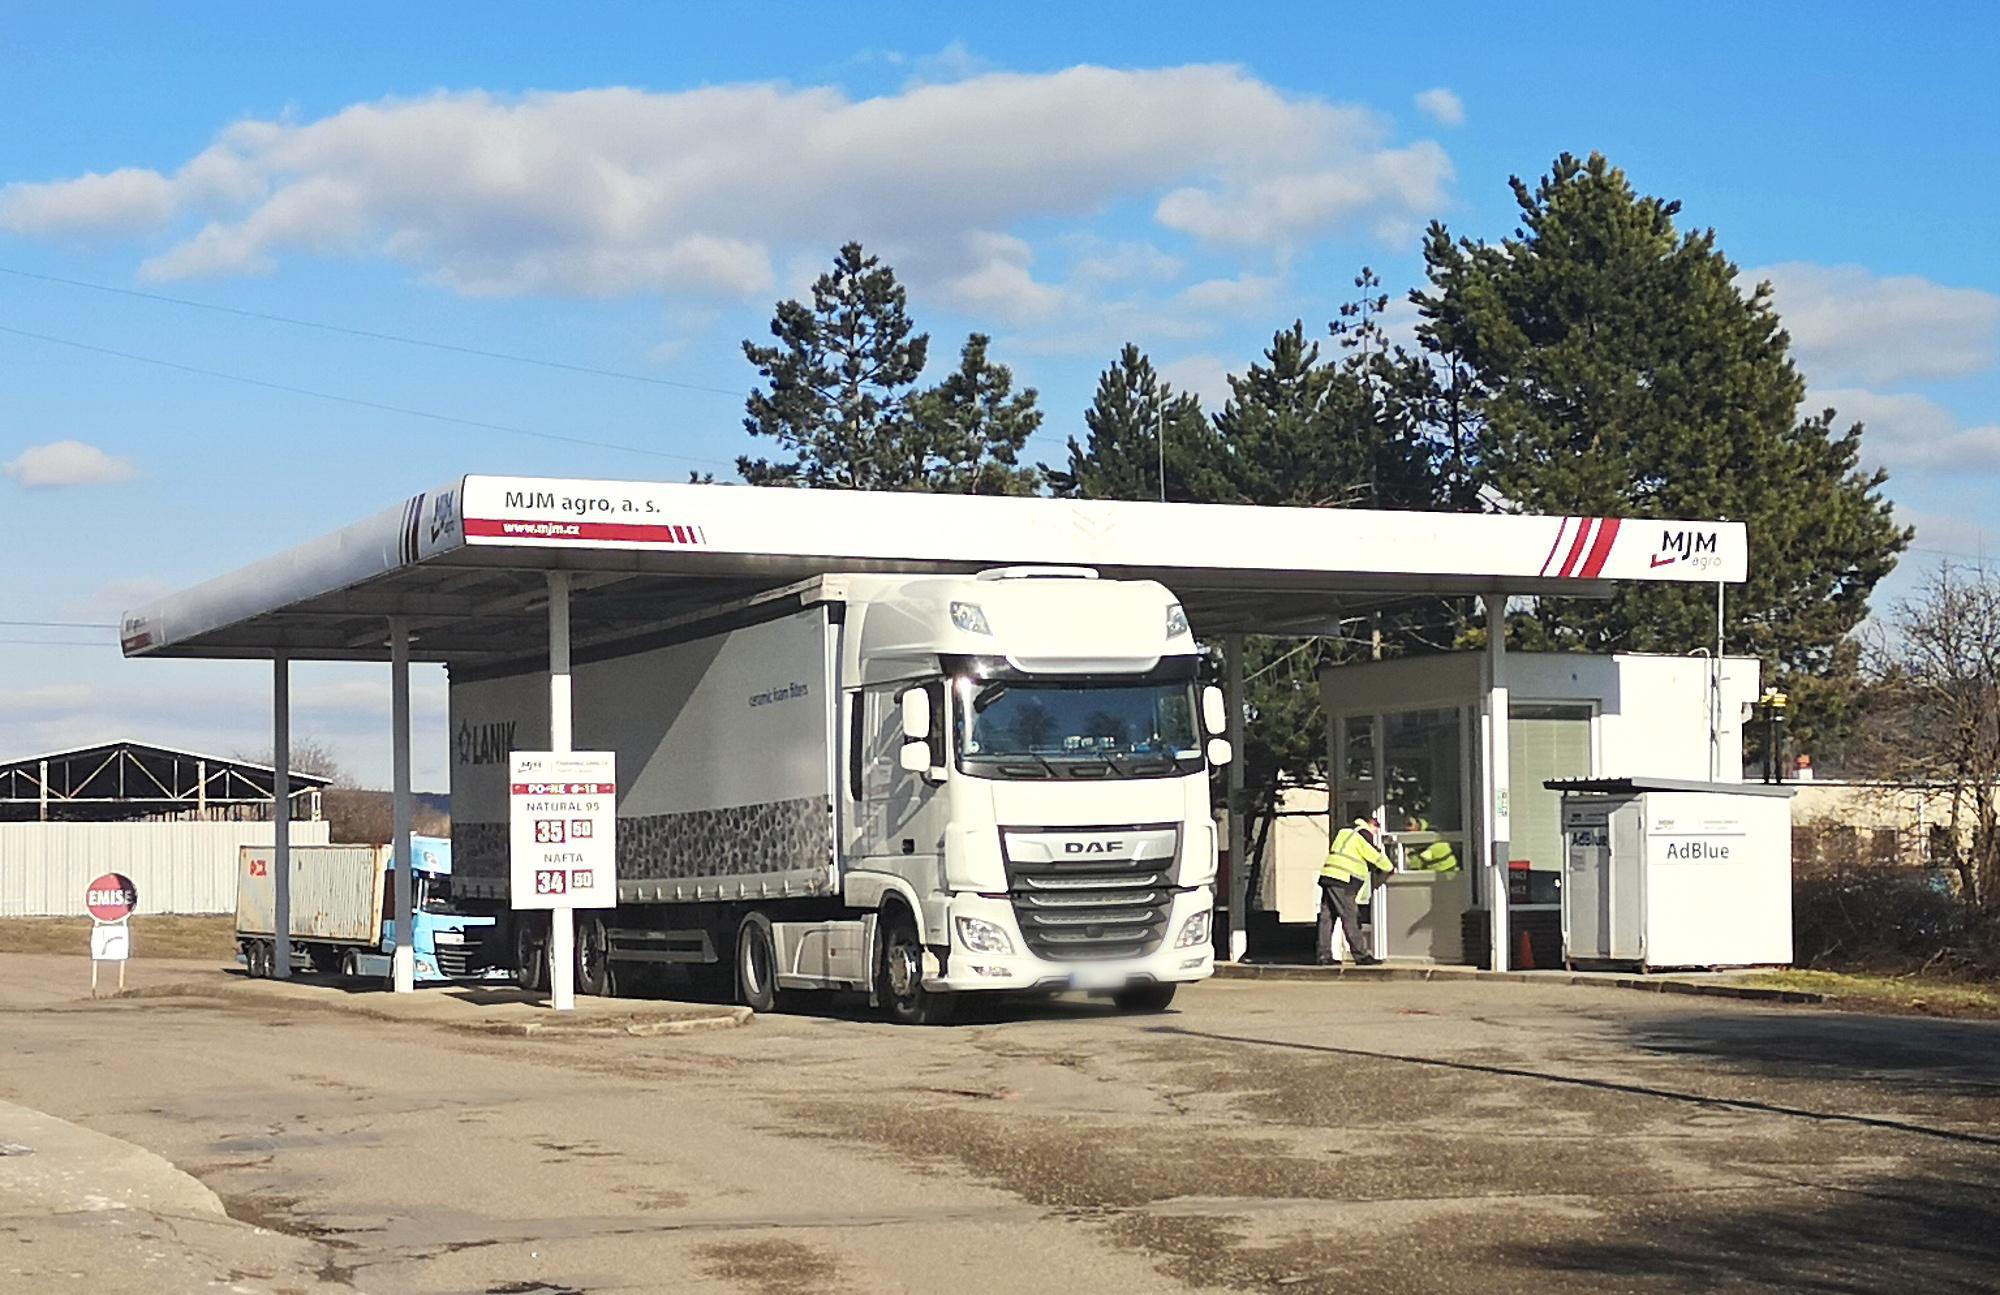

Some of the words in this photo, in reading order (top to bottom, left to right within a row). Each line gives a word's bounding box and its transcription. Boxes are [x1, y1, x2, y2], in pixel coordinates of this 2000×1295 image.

[505, 491, 555, 509] MJM
[561, 497, 615, 515] agro,
[622, 500, 639, 512] a.
[645, 501, 660, 513] s.
[503, 523, 581, 535] www.mjm.cz
[1662, 529, 1717, 560] MJM
[1692, 557, 1722, 571] agro
[526, 802, 582, 812] NATURAL
[536, 821, 563, 843] 35
[1065, 841, 1123, 853] DAF
[1667, 842, 1730, 859] AdBlue
[544, 852, 583, 863] NAFTA
[537, 871, 564, 894] 34
[88, 889, 134, 906] EMISE
